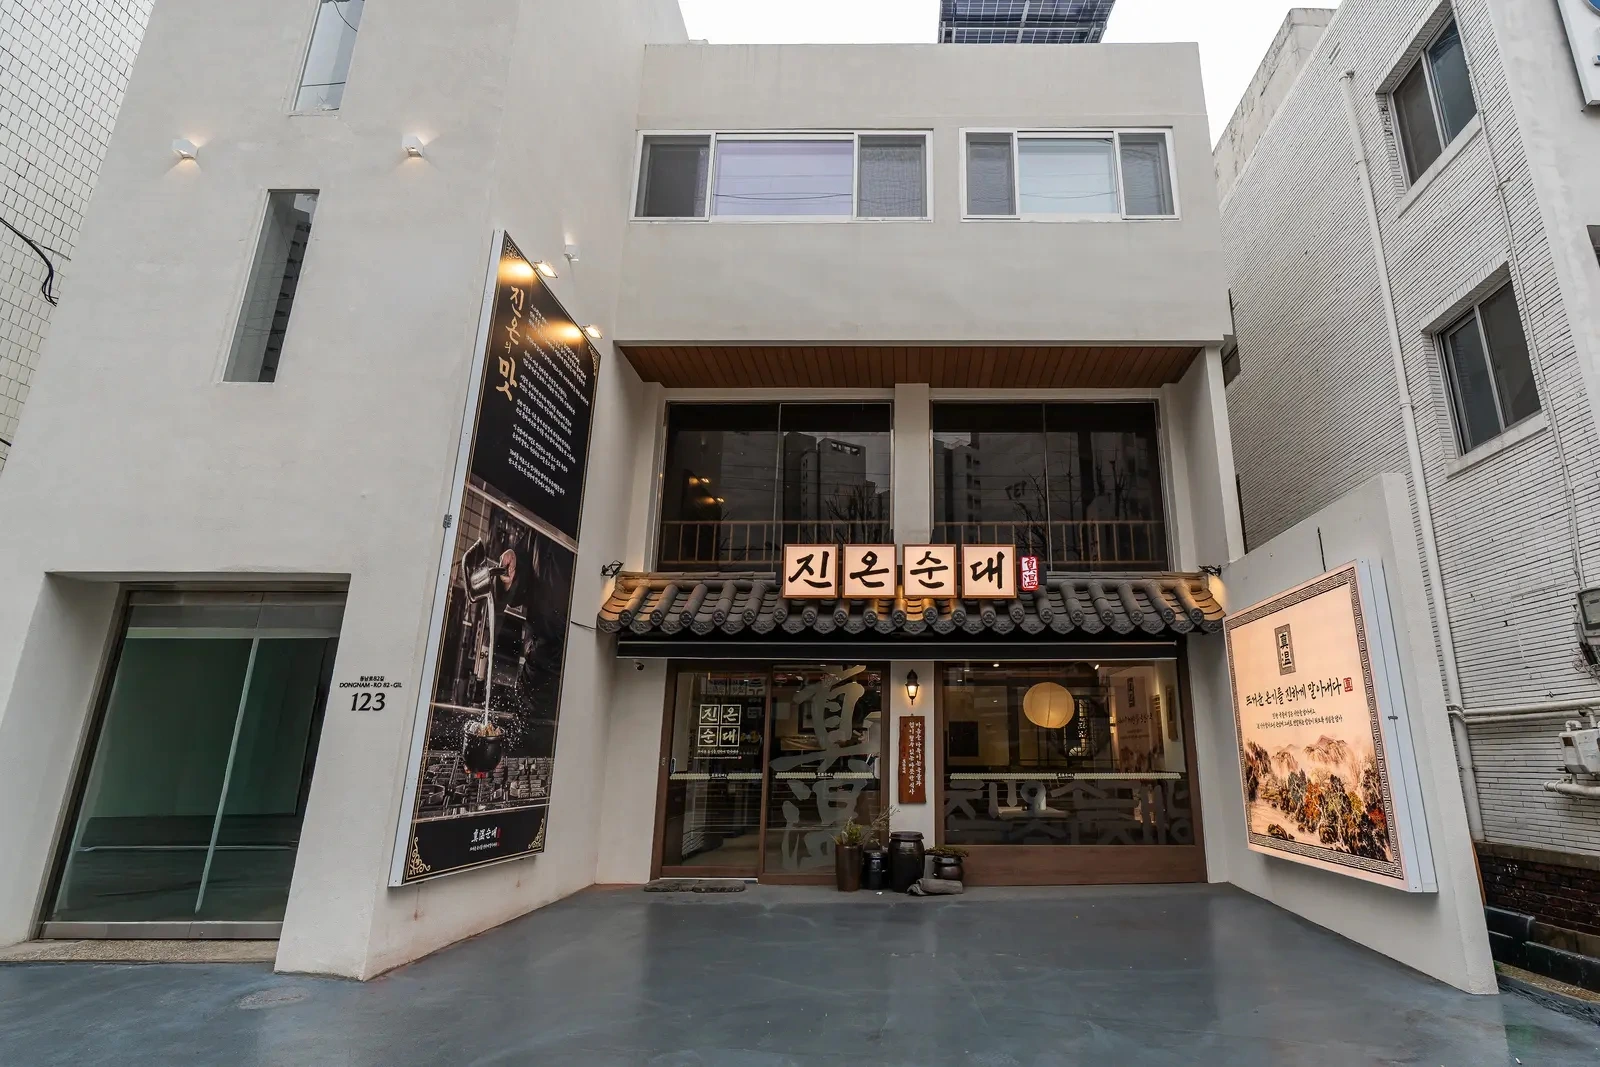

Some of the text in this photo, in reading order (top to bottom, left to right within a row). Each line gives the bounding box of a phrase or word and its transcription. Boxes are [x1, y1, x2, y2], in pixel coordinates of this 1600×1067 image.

[496, 285, 525, 401] 진온의 맛
[788, 550, 1006, 589] 진온순대
[351, 692, 386, 711] 123
[1245, 693, 1264, 707] 뜨거운
[1265, 687, 1284, 706] 온기를
[1285, 684, 1307, 702] 진하게
